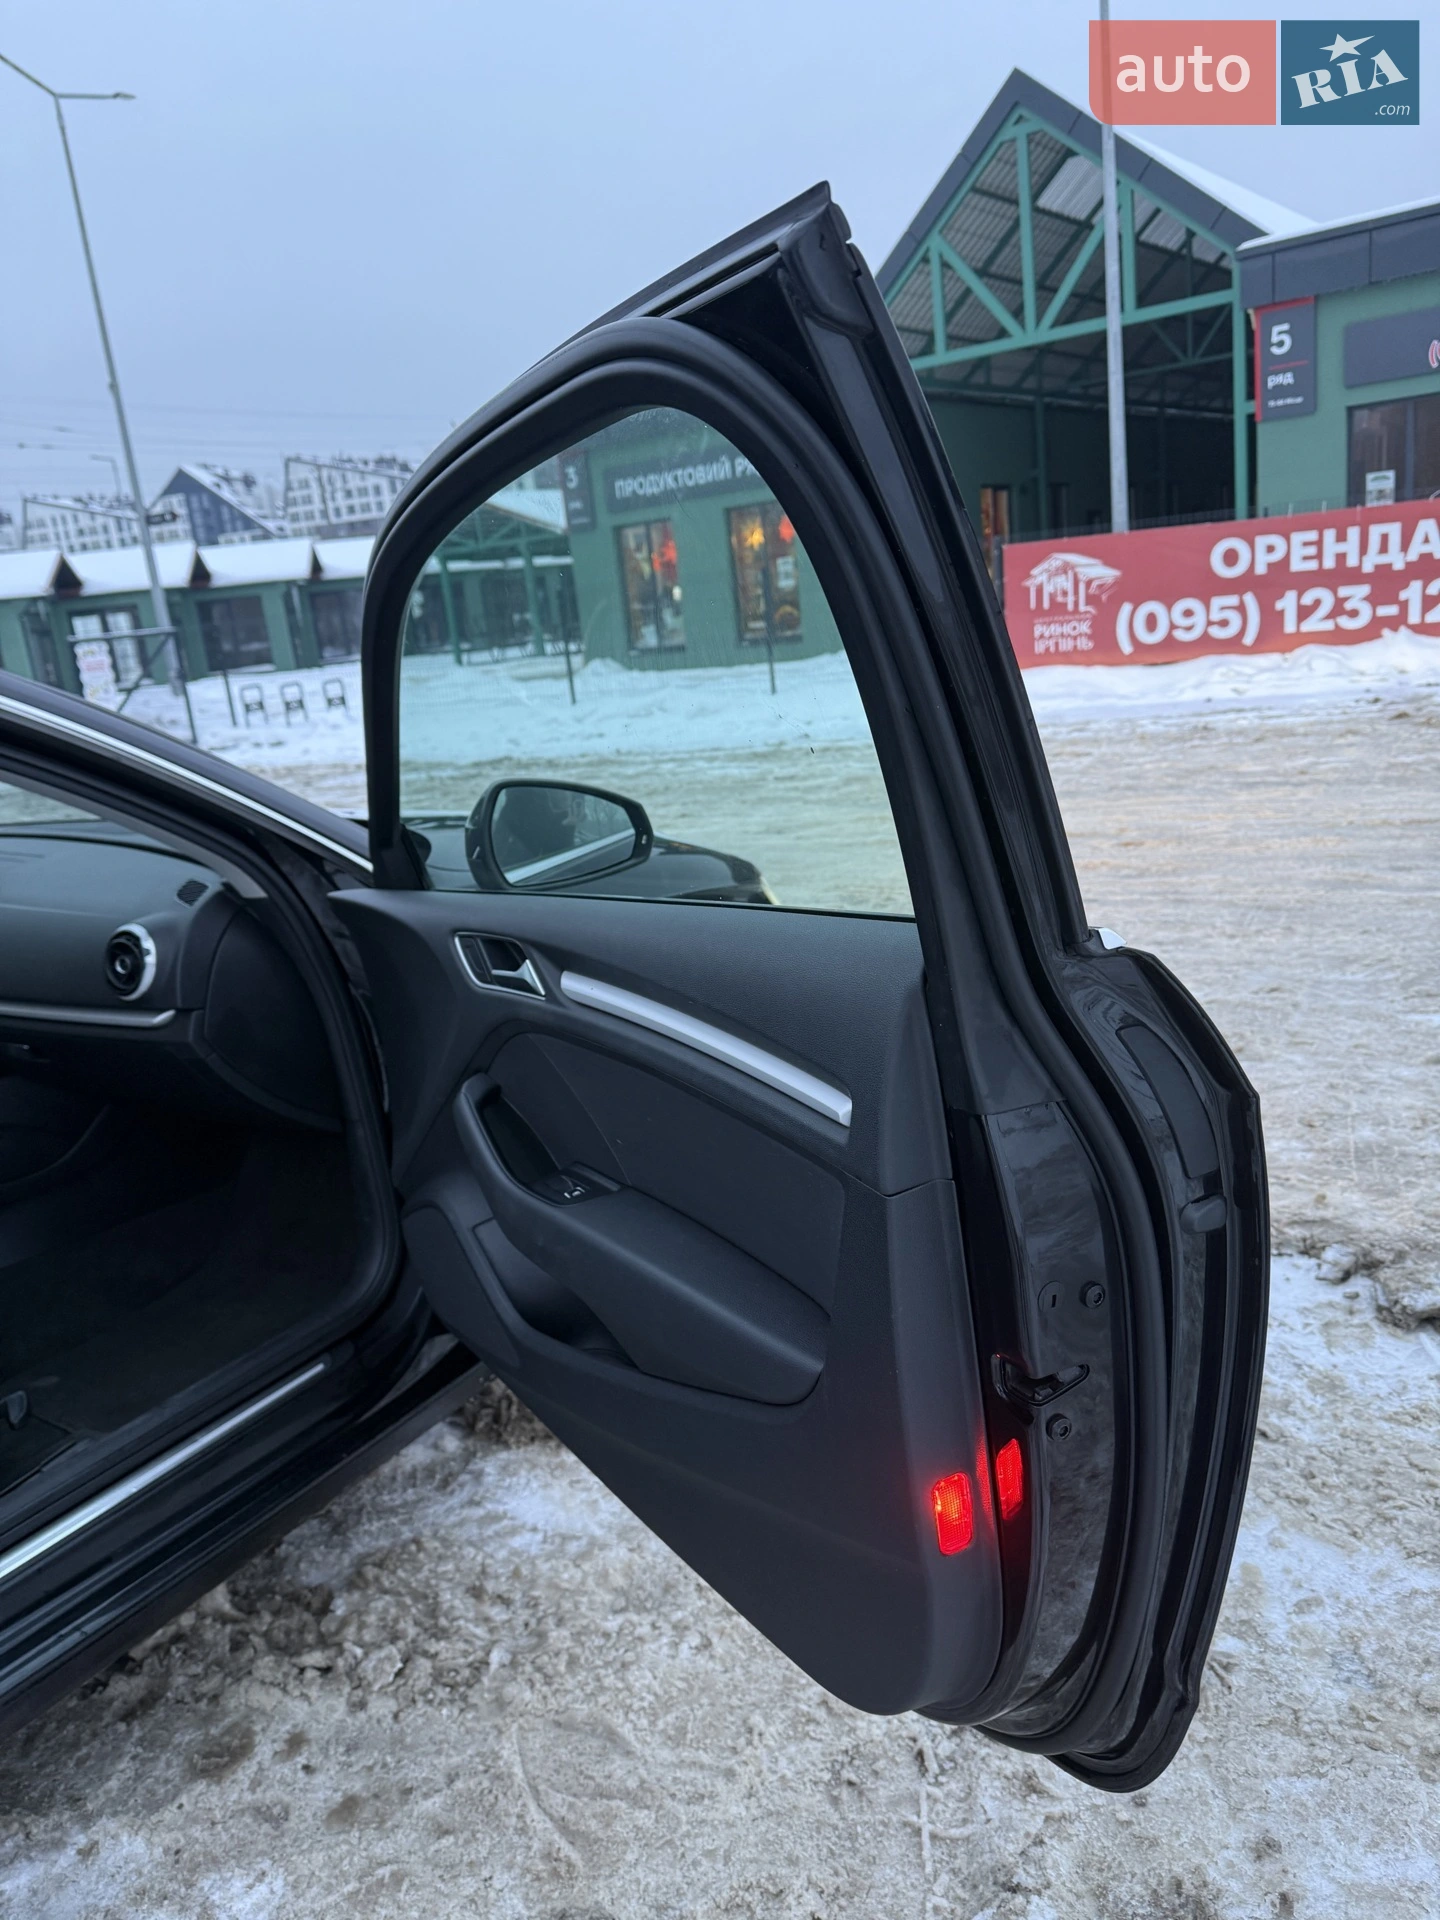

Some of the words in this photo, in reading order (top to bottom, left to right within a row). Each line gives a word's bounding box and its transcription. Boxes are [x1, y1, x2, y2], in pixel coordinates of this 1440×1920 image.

[1269, 322, 1293, 355] 5
[614, 456, 733, 499] ПРОДУКТОВИЙ
[1209, 518, 1440, 579] ОРЕНДА
[1033, 620, 1092, 639] РИНОК
[1115, 591, 1261, 656] (095)
